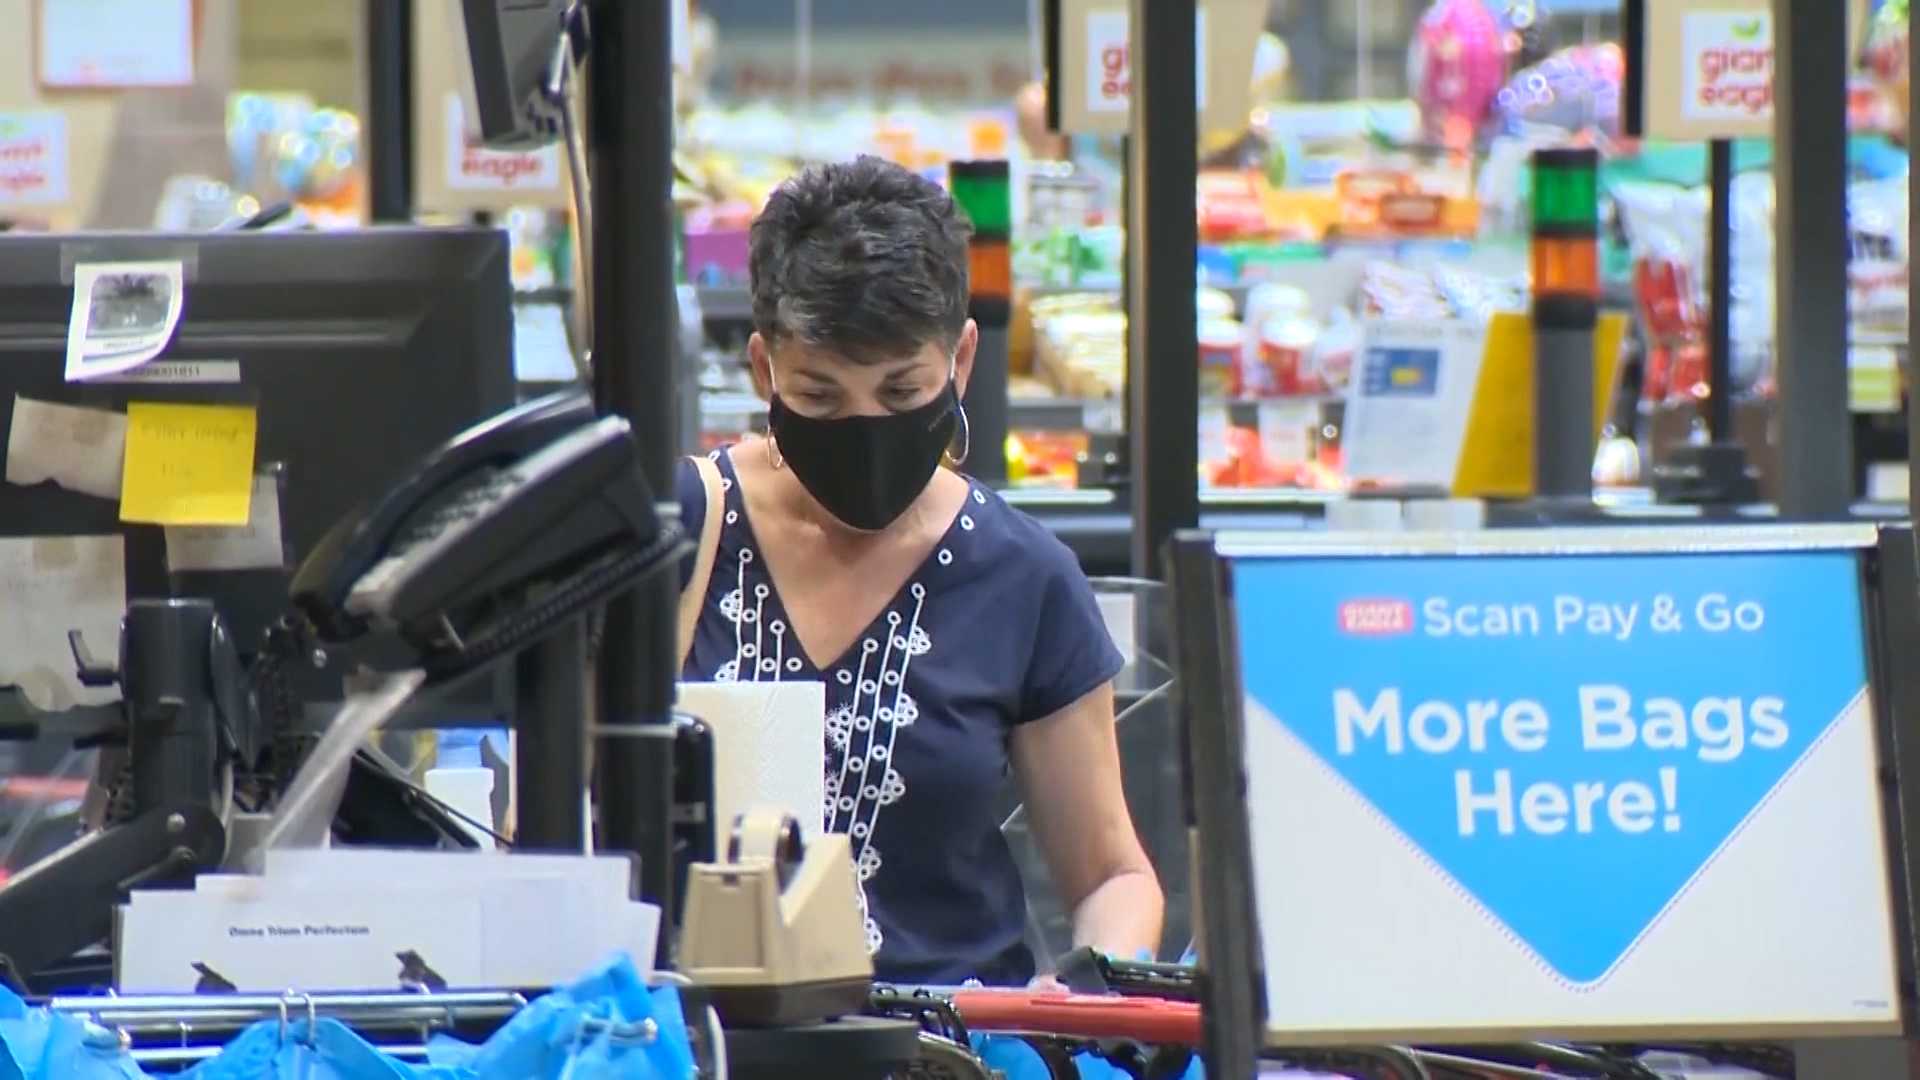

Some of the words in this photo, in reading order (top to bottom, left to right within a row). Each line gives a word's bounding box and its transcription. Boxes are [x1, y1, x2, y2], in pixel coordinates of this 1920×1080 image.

[1700, 79, 1775, 112] eagl
[1423, 596, 1541, 637] Scan
[1553, 593, 1640, 641] Pay
[1650, 592, 1683, 633] &
[1694, 591, 1765, 633] Go
[1333, 688, 1551, 755] More
[1578, 684, 1790, 764] Bags
[1455, 766, 1682, 836] Here!
